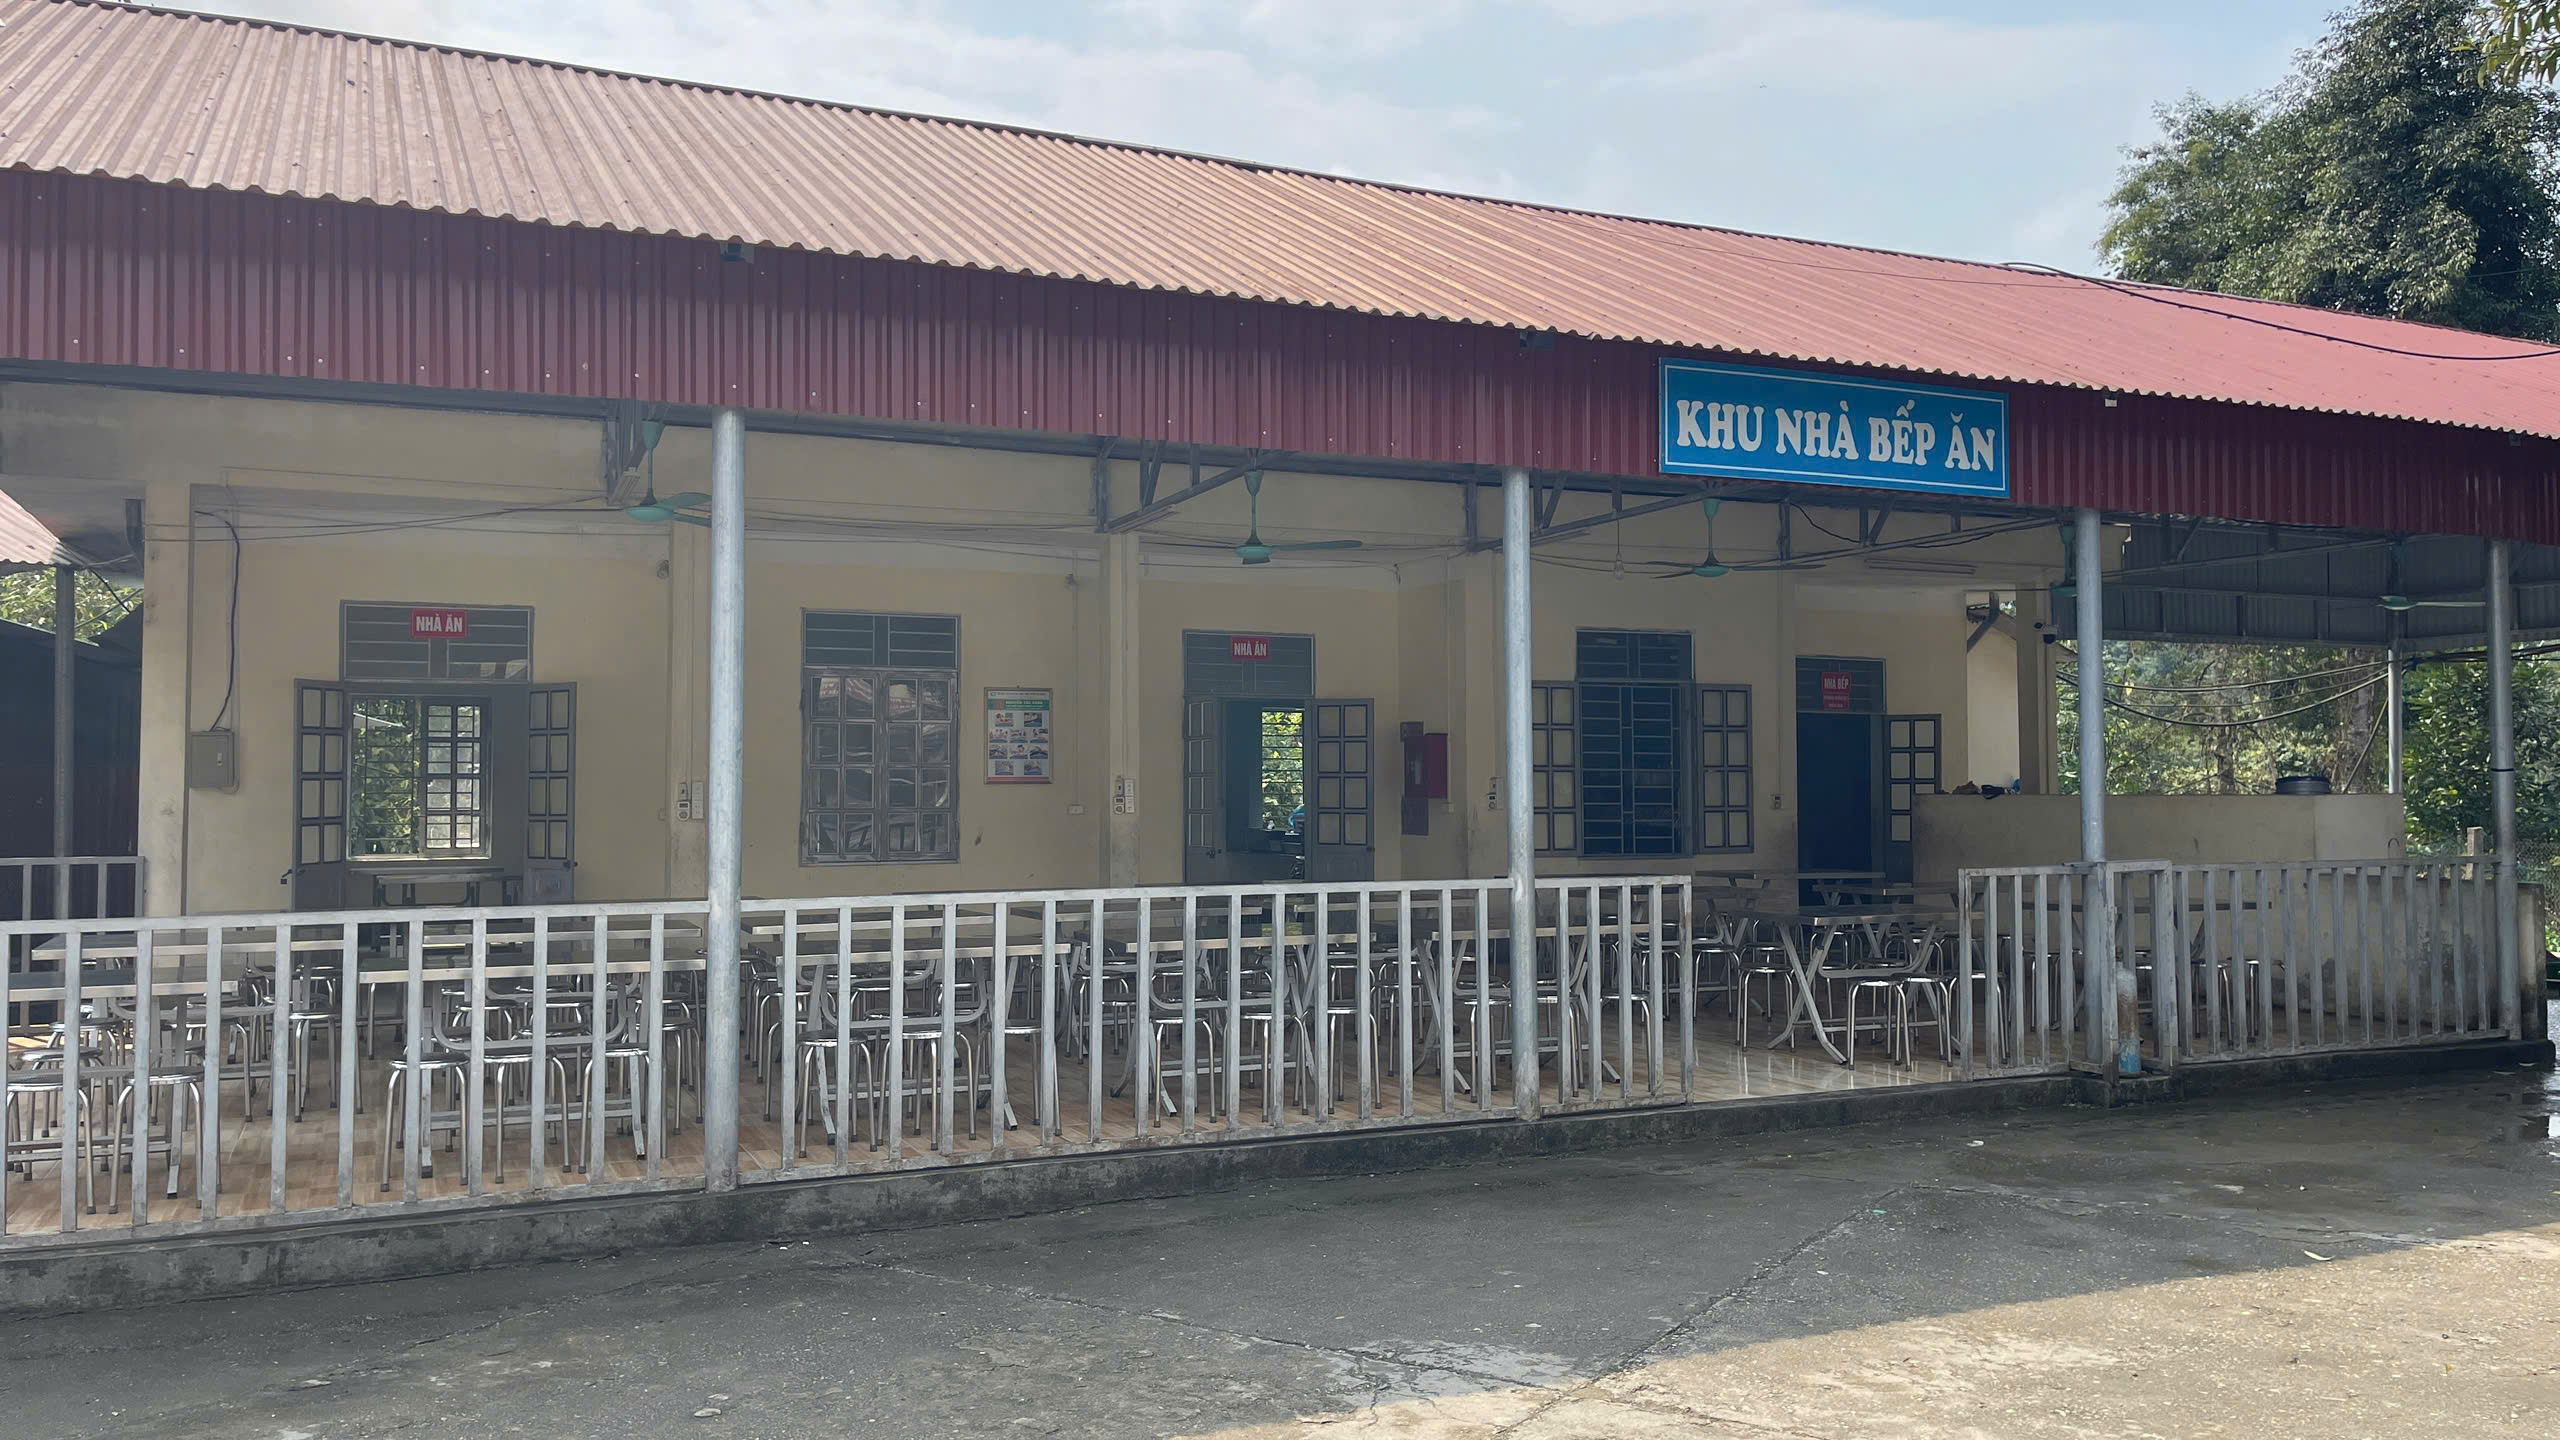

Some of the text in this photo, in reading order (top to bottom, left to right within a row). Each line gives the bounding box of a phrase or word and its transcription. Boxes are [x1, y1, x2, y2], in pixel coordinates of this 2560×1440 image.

[1676, 399, 1996, 472] KHU NHÀ BẾP ĂN
[416, 613, 463, 633] NHÀ ĂN
[1234, 640, 1267, 657] NHÀ ĂN
